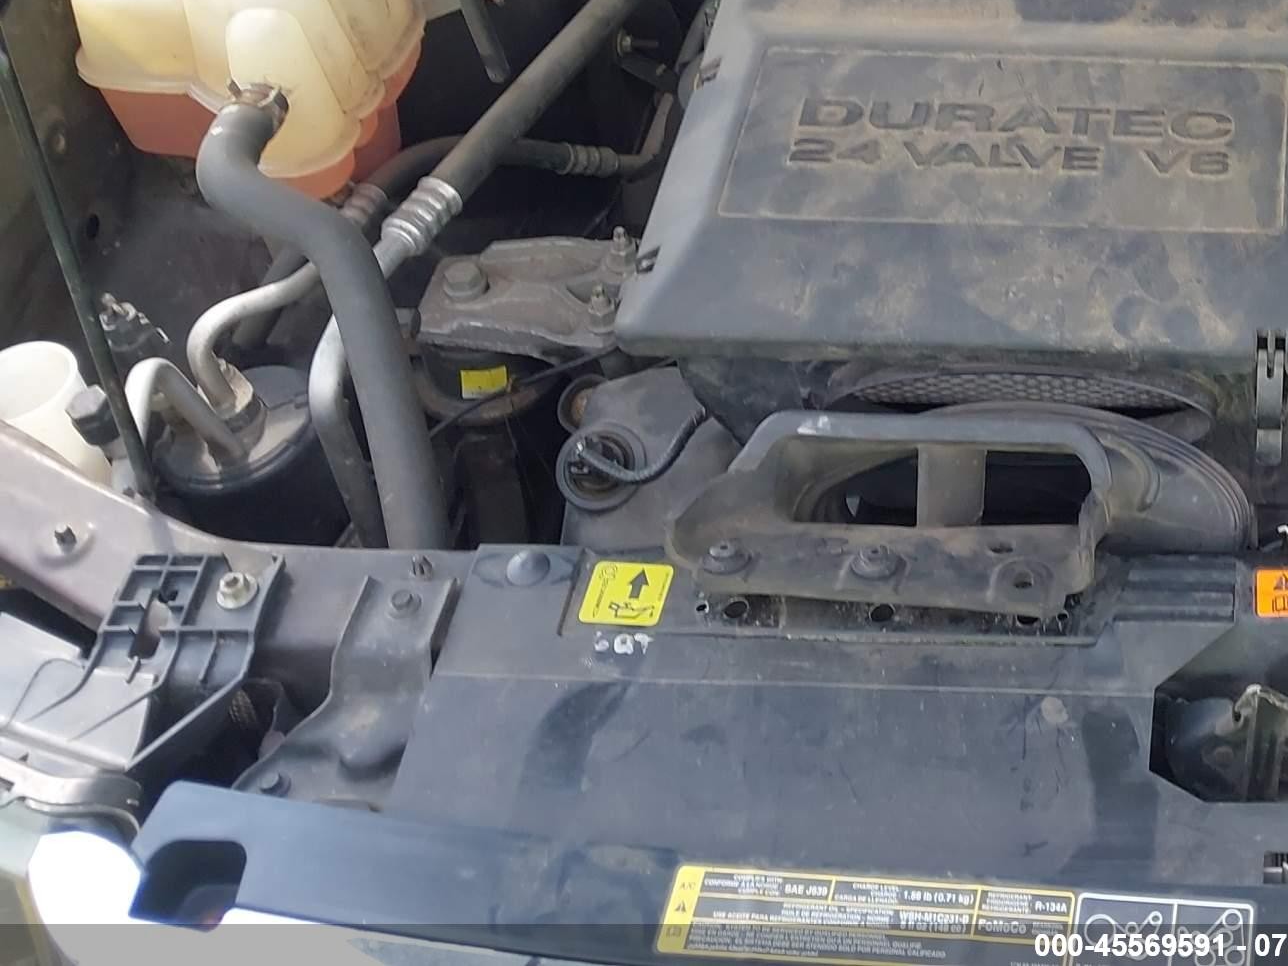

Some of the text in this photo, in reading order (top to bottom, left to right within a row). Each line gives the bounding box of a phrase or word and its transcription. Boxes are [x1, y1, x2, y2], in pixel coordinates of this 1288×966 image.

[798, 97, 1235, 142] DURATEC
[787, 137, 1230, 176] 24 VALVE V6
[784, 883, 805, 895] SAE
[958, 893, 974, 906] kg)
[1035, 900, 1067, 913] R-134A
[977, 918, 1027, 934] FoMoCo
